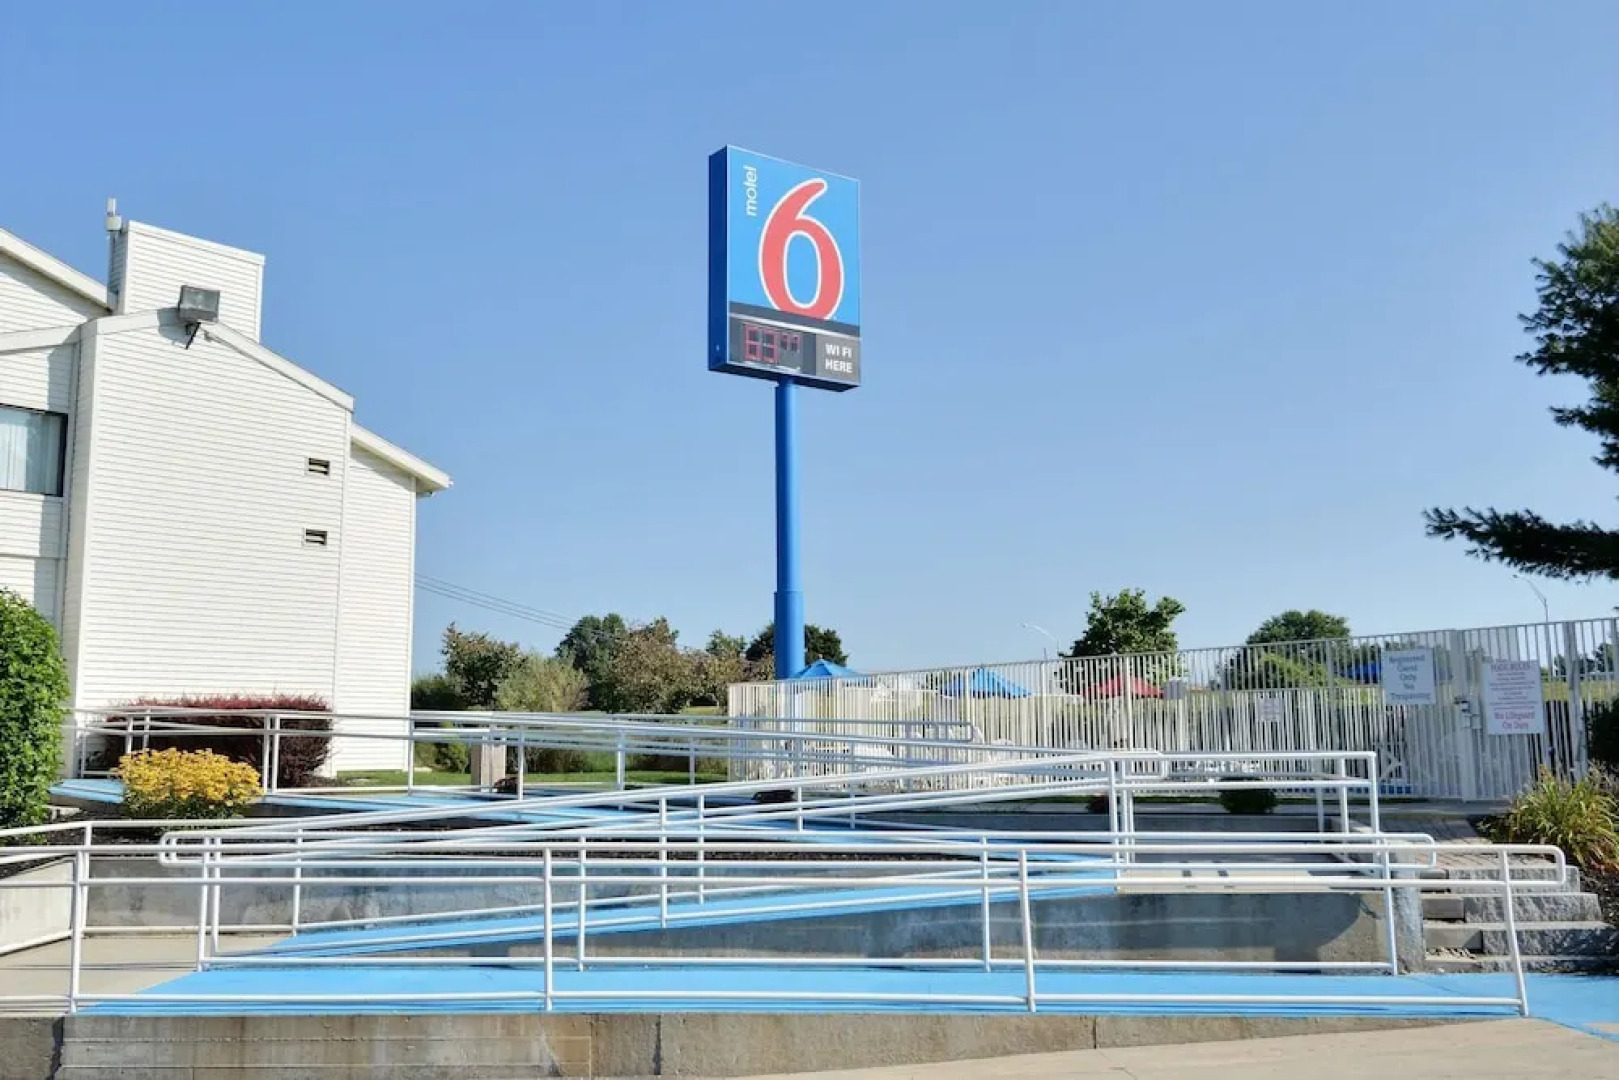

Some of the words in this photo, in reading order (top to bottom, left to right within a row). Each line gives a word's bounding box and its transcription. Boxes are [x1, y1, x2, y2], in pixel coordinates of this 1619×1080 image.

[743, 165, 757, 216] motel
[758, 177, 845, 321] 6
[825, 358, 853, 373] HERE
